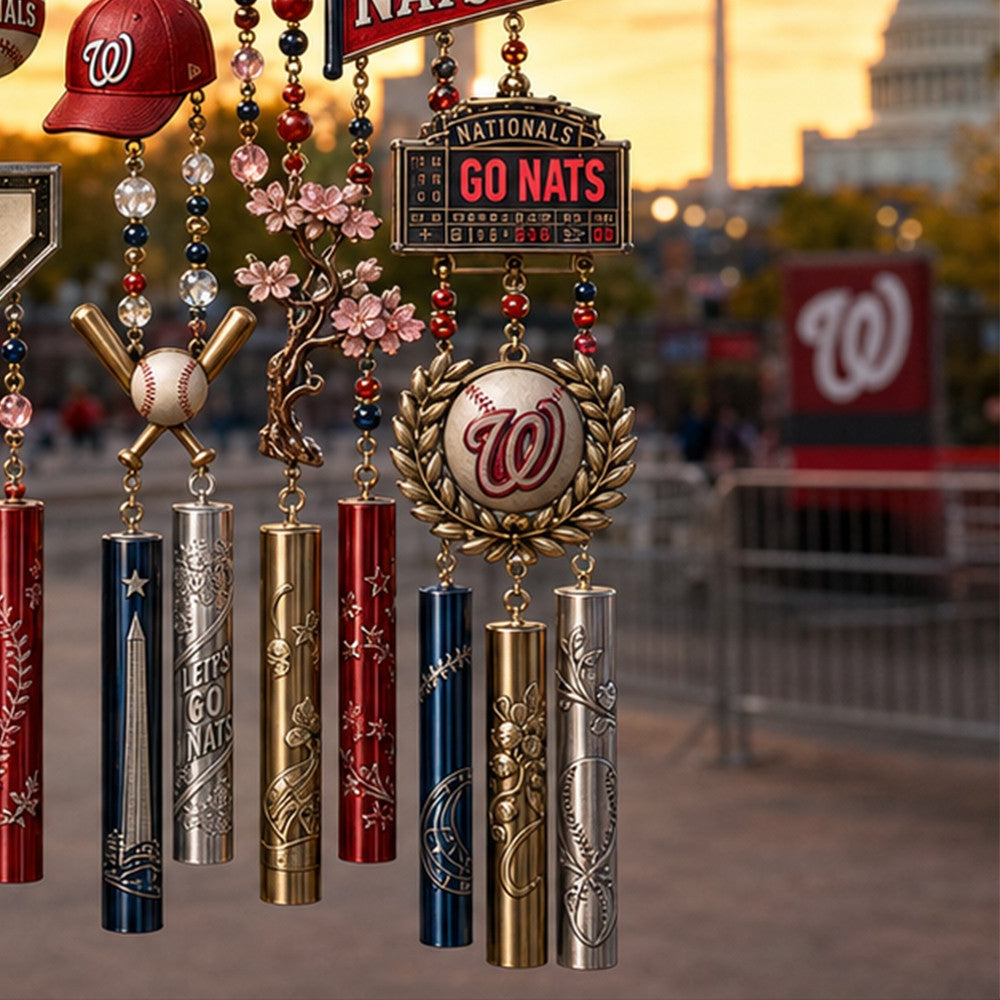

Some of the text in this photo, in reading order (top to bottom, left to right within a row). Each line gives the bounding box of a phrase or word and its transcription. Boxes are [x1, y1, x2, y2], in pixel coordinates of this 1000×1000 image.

[82, 32, 135, 87] W
[456, 117, 574, 146] NATIONALS
[460, 157, 508, 203] GO
[518, 157, 606, 203] NATS
[794, 270, 914, 405] W
[463, 398, 566, 498] W
[187, 684, 224, 725] GO
[186, 714, 233, 763] NATS
